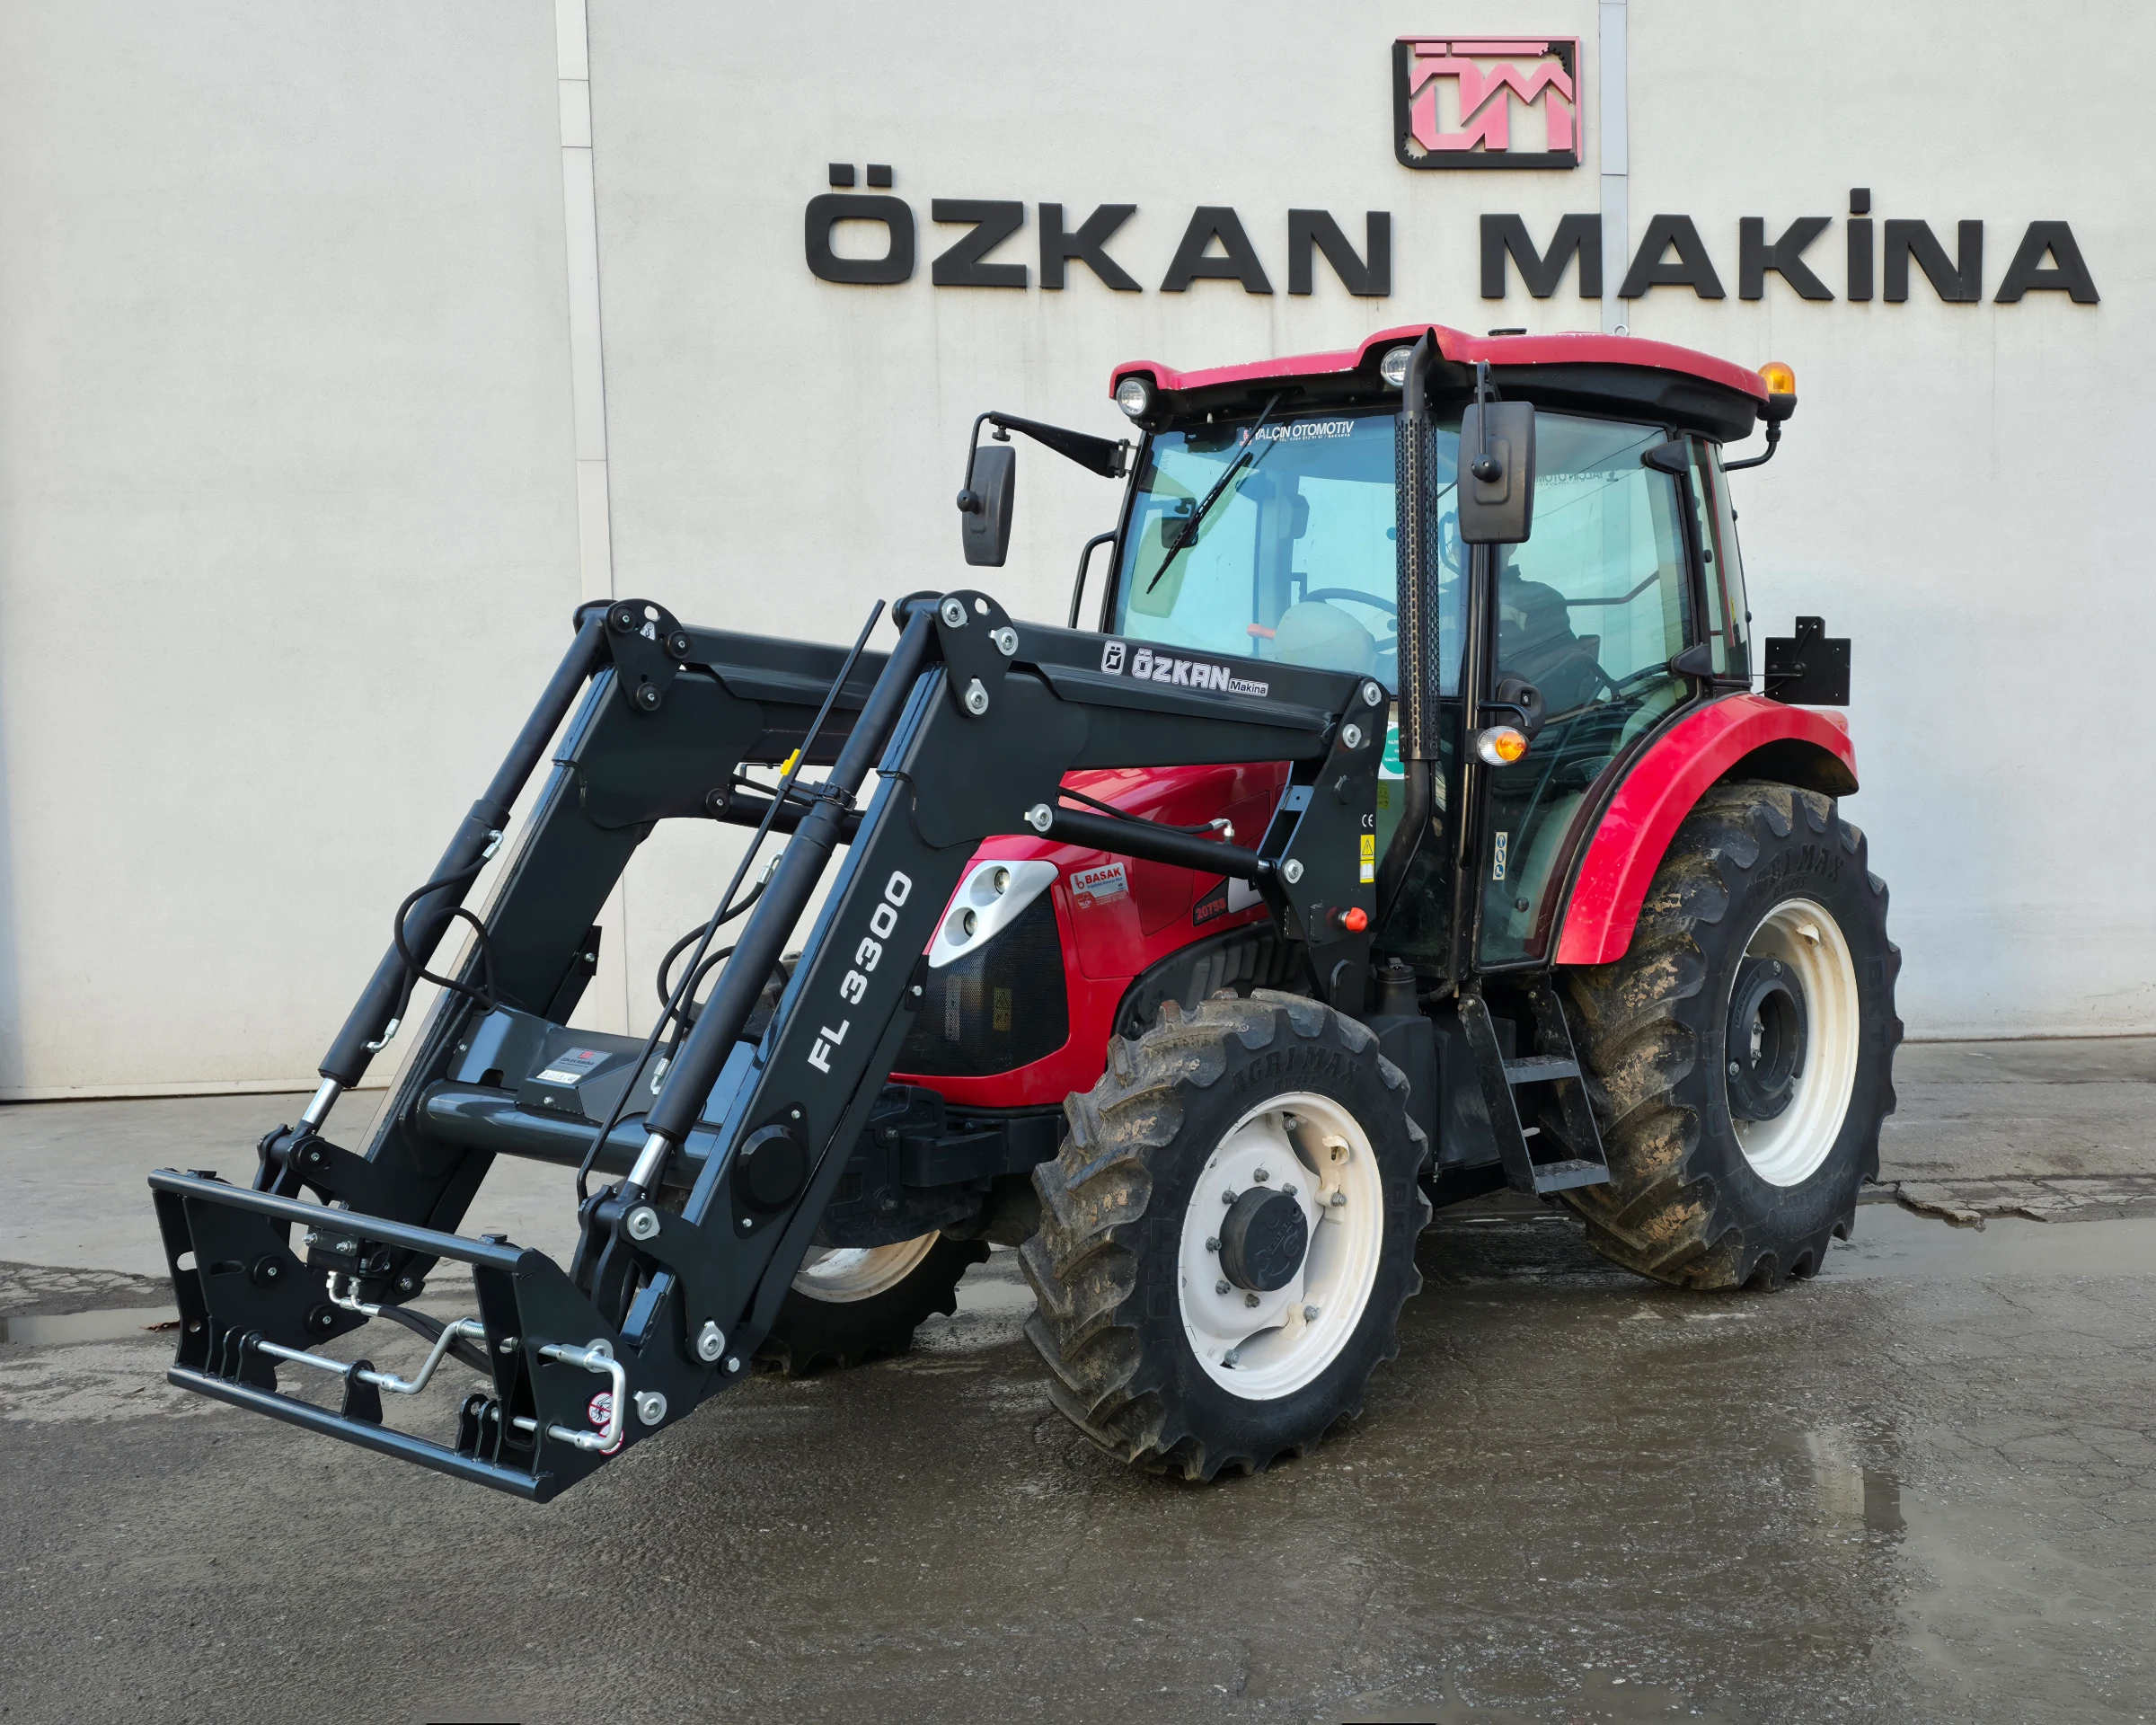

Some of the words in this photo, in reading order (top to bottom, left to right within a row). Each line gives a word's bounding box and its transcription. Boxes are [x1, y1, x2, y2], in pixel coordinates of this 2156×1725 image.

[805, 163, 1392, 296] ÖZKAN
[1480, 188, 2101, 304] MAKİNA
[1293, 421, 1354, 437] OTOMOTİV
[1132, 648, 1231, 691] ÖZKAN
[1230, 680, 1267, 694] Makina
[807, 1019, 851, 1075] FL
[839, 870, 913, 1005] 3300
